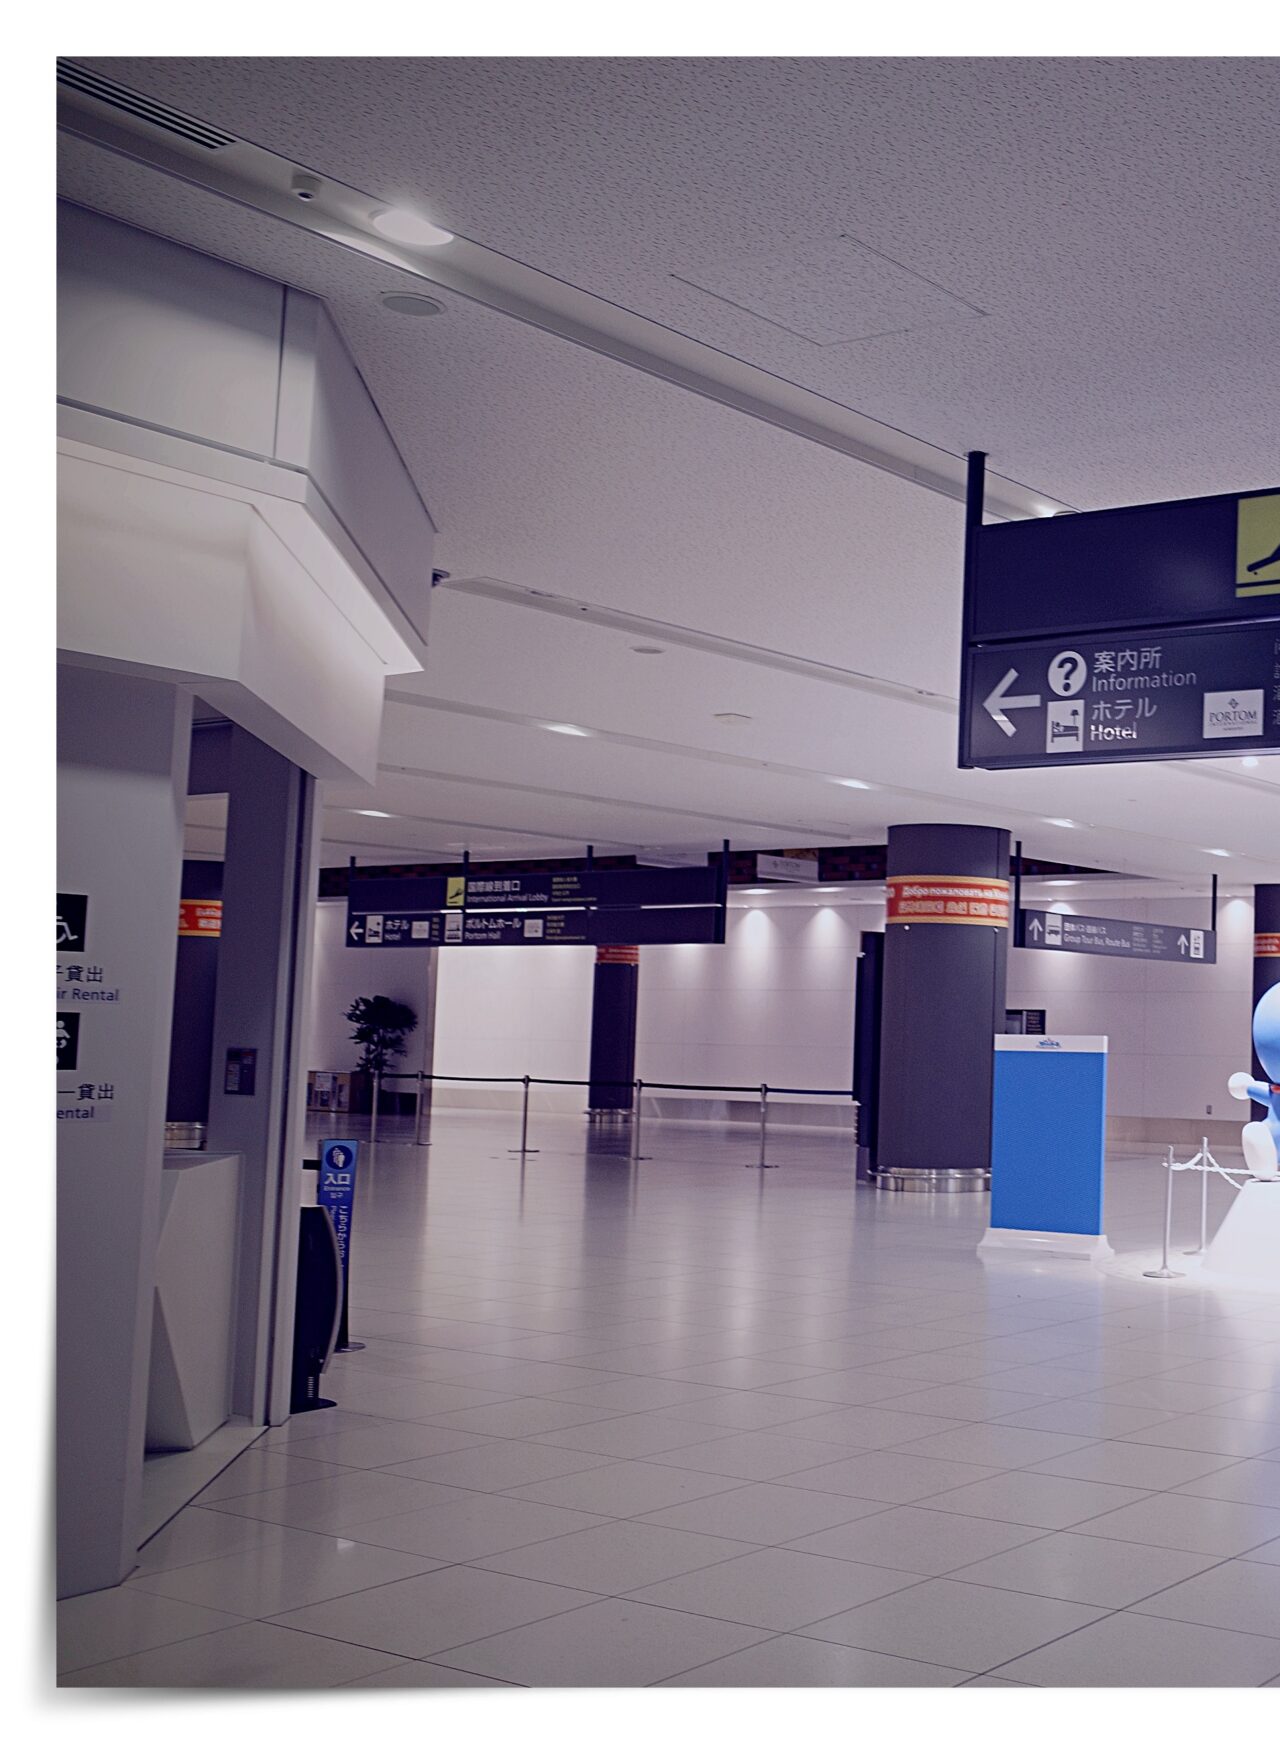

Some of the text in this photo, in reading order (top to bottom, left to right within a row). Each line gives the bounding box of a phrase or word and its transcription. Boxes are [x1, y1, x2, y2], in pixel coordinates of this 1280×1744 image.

[1094, 647, 1163, 674] 案内所
[1092, 670, 1197, 692] Information
[1092, 697, 1158, 721] ホテル
[1209, 710, 1257, 722] PORTOM
[1090, 721, 1138, 741] Hotel
[385, 920, 409, 930] ホテル
[73, 987, 119, 1001] Rental
[56, 1106, 95, 1119] ental
[324, 1173, 350, 1185] 入口
